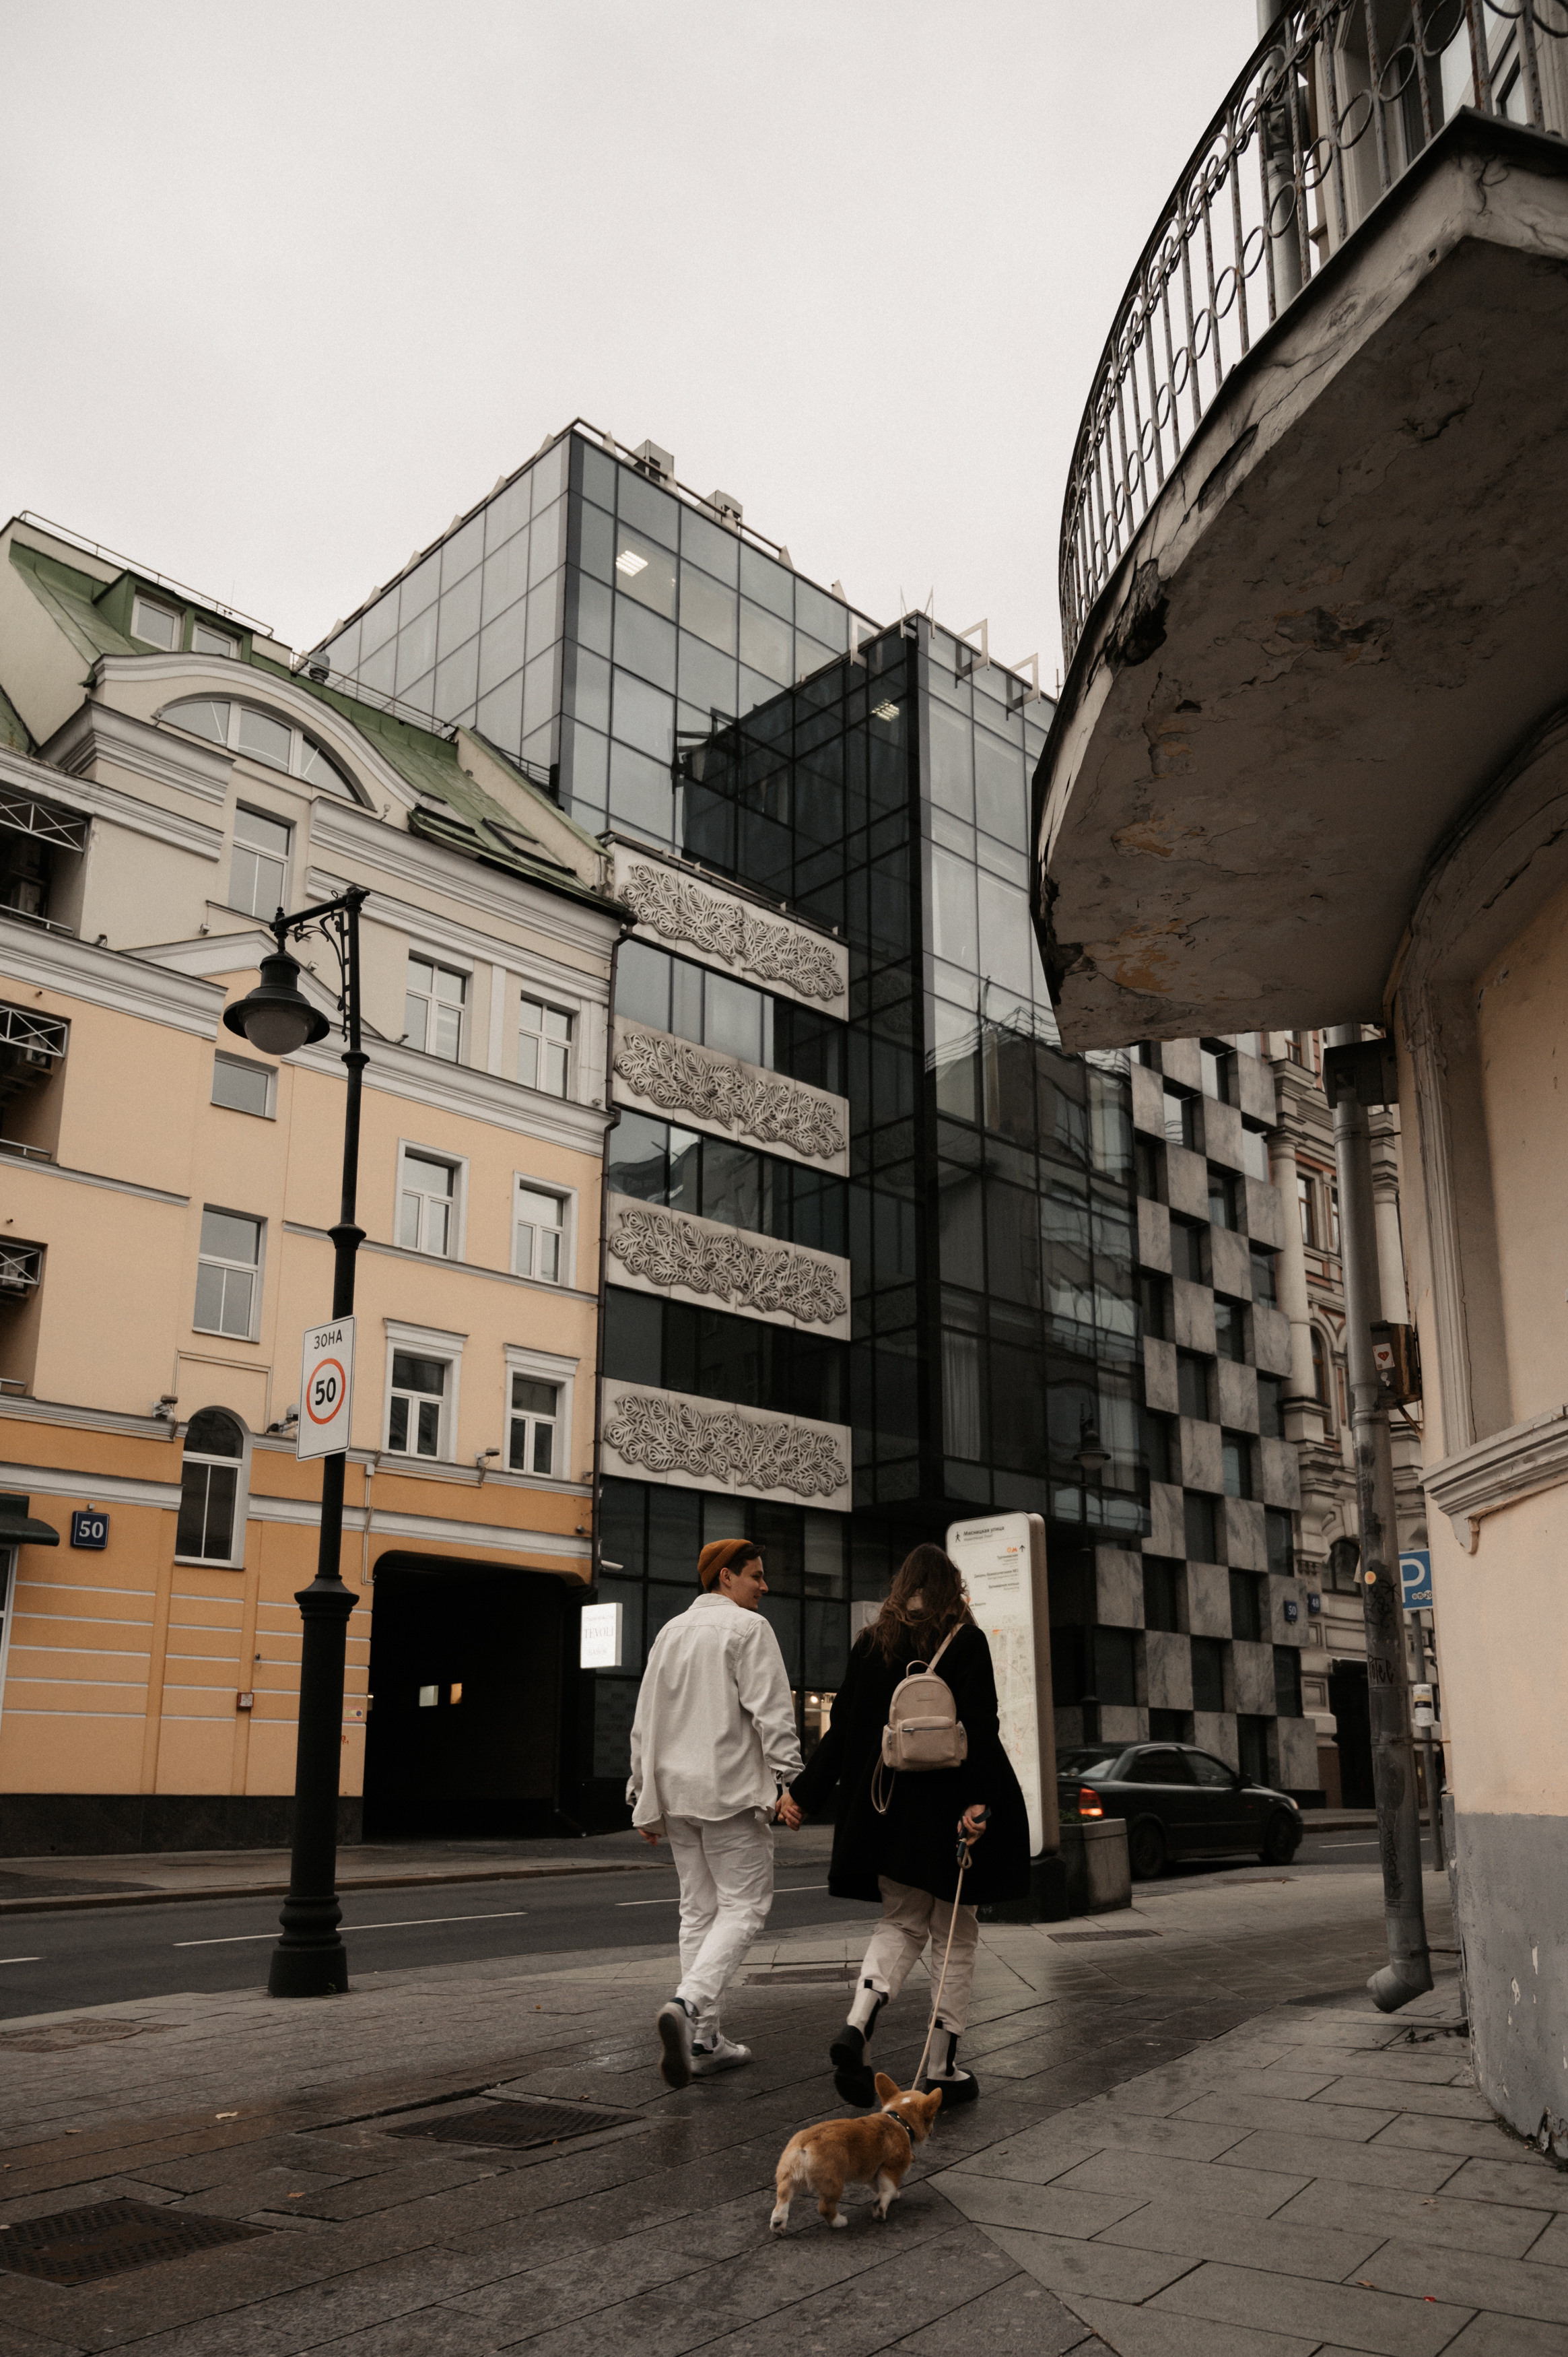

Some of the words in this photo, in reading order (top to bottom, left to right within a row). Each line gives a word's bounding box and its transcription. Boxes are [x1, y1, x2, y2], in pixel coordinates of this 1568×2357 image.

[314, 1329, 343, 1350] ЗОНА
[315, 1377, 336, 1406] 50
[79, 1520, 104, 1539] 50
[1400, 1558, 1425, 1603] P
[1288, 1605, 1296, 1615] 50
[1311, 1598, 1319, 1607] 48
